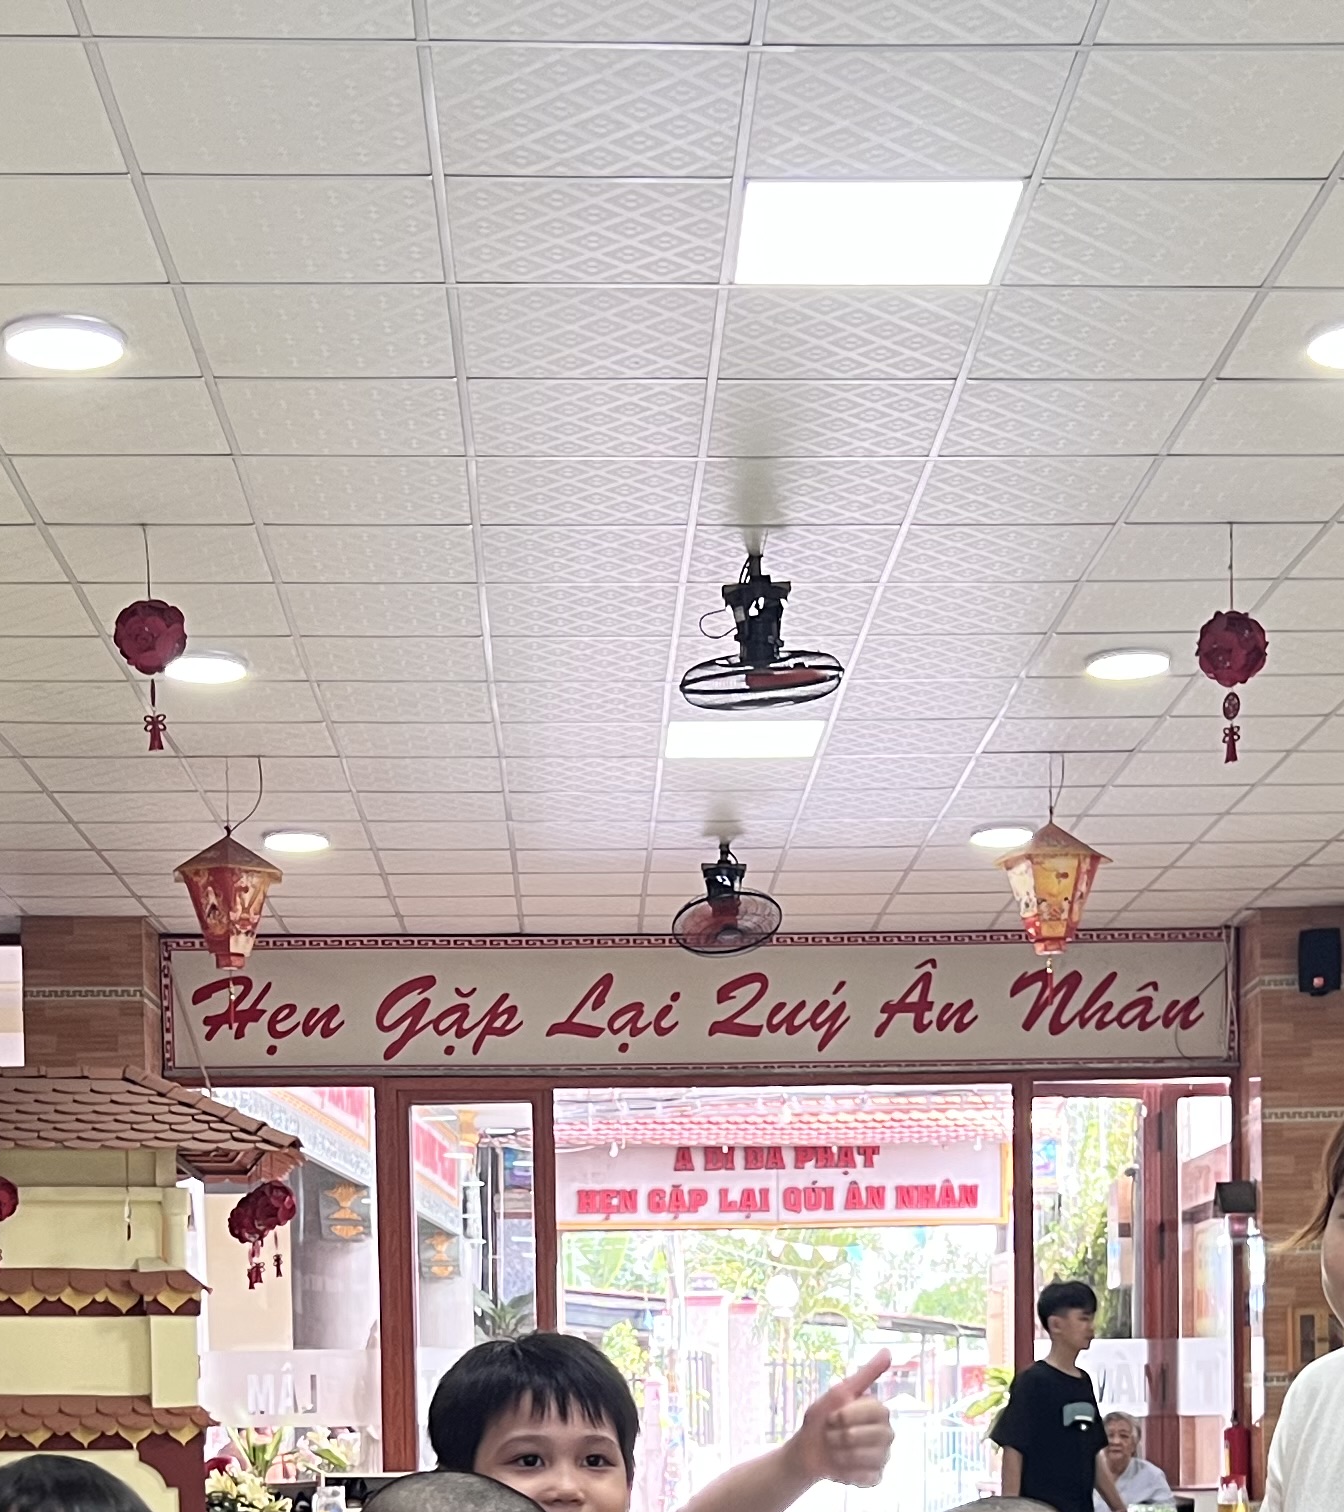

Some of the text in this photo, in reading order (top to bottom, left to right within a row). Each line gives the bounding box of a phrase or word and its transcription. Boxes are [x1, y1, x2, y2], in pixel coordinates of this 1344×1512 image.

[192, 958, 1205, 1060] Hẹn Gặp Lại Quý Ân Nhân
[577, 1189, 638, 1221] HẸN
[647, 1184, 709, 1220] GẶP
[719, 1188, 770, 1219] LẠI
[844, 1180, 886, 1210] ÂN
[895, 1178, 979, 1210] NHÂN
